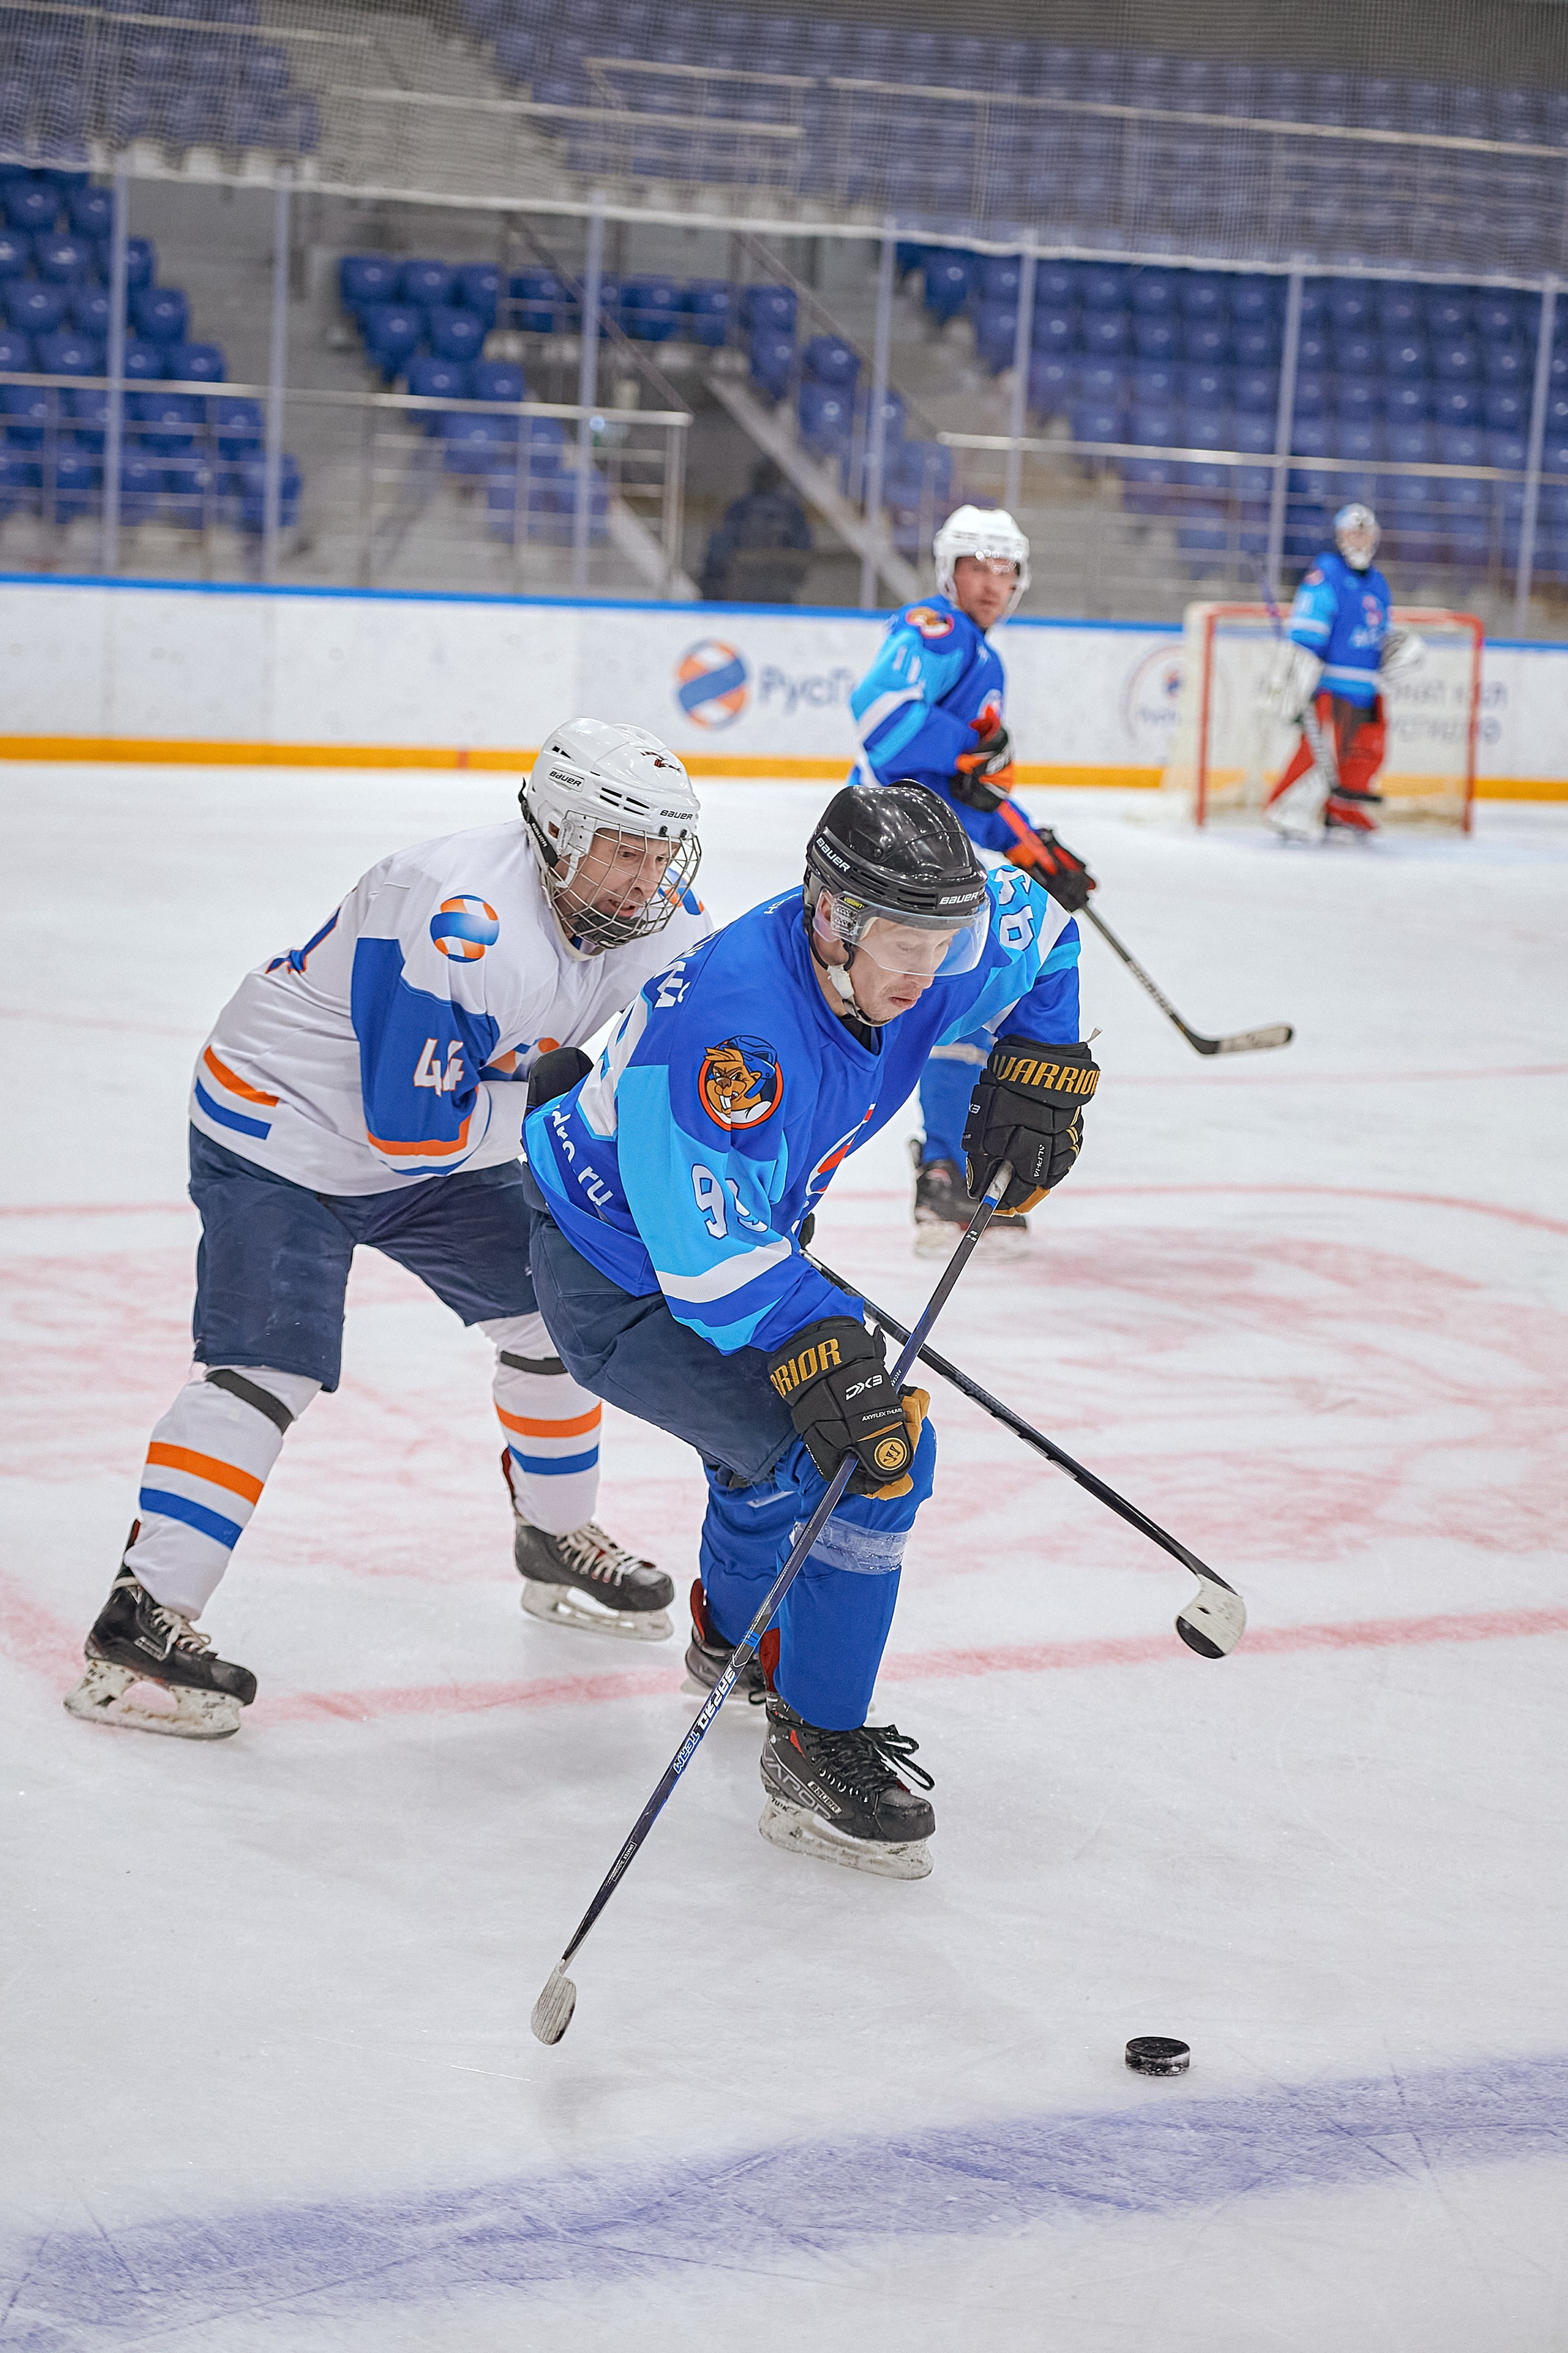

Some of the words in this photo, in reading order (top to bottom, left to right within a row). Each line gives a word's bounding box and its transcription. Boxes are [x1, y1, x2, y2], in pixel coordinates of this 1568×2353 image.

[549, 770, 582, 787] BAUER
[659, 809, 693, 821] BAUER
[815, 837, 851, 872] BAUER
[939, 890, 979, 905] BAUER
[1033, 1144, 1046, 1178] ALPHA
[845, 1374, 883, 1401] DX3
[861, 1409, 886, 1422] AXYFLEX
[673, 1730, 700, 1774] TEAM
